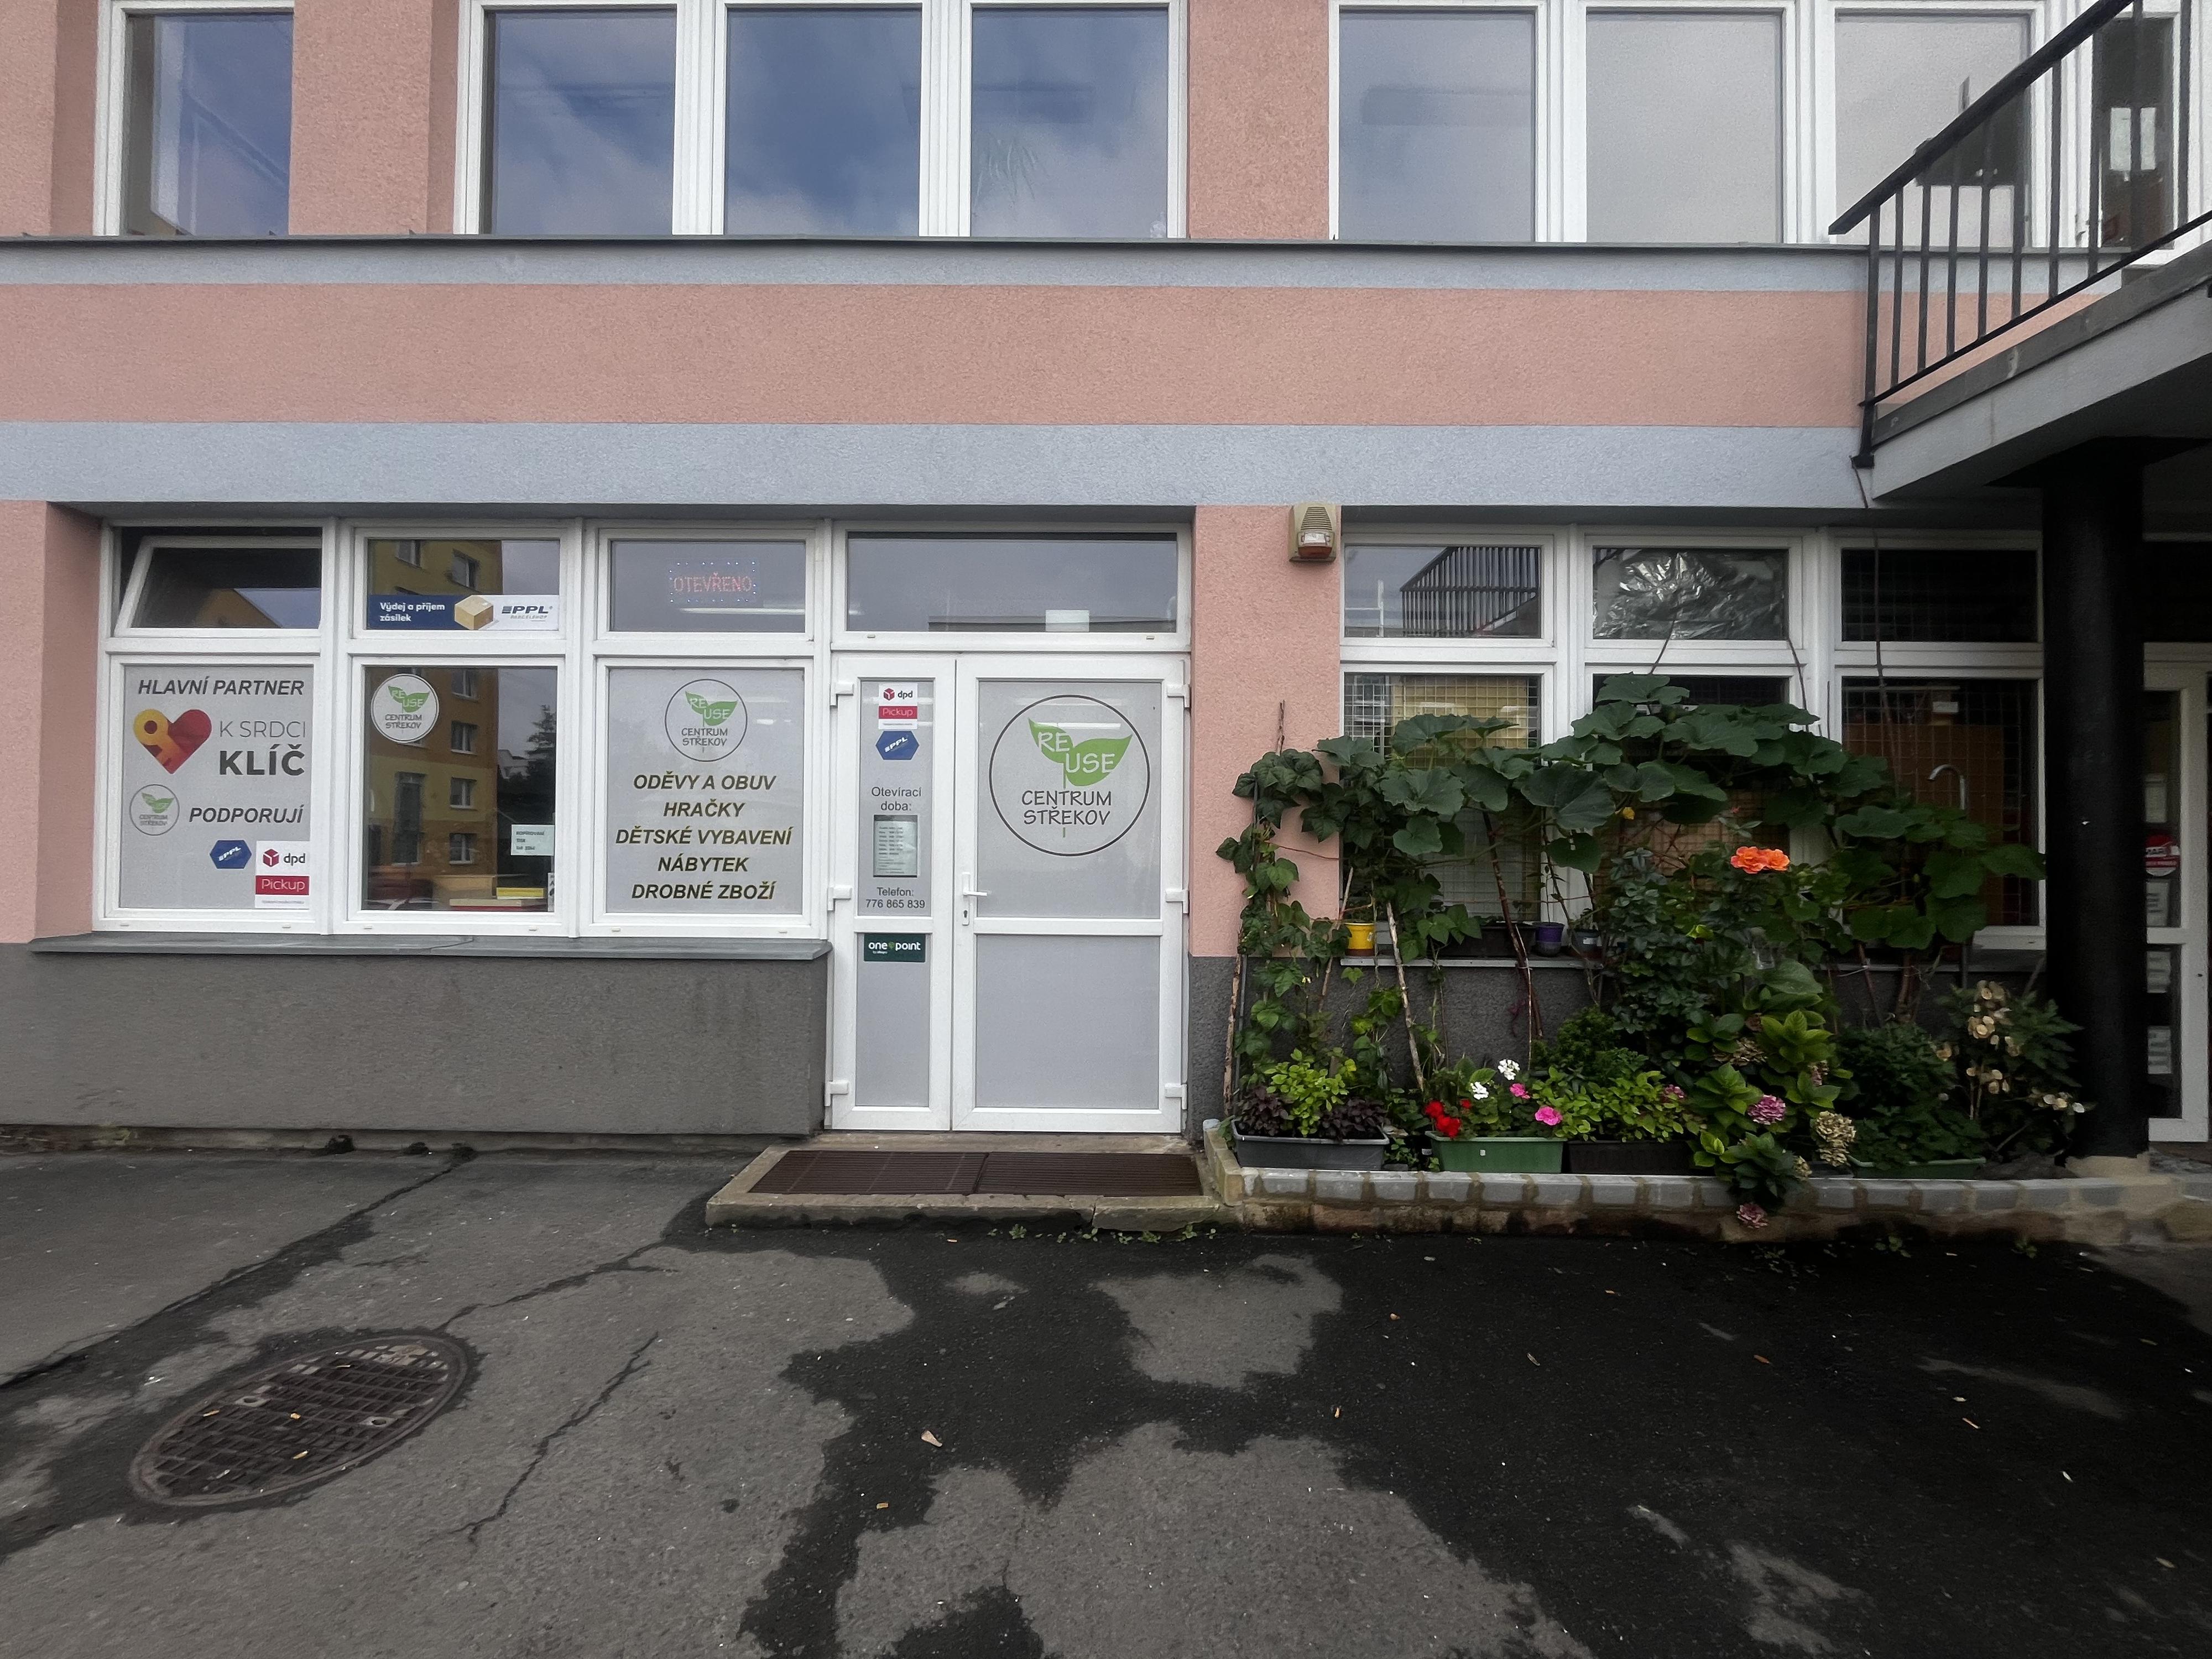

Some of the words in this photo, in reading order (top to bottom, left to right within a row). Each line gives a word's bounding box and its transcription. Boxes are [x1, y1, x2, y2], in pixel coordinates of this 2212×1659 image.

[673, 572, 752, 593] OTEVŘENO
[380, 602, 406, 612] Výdej
[416, 602, 445, 612] příjem
[138, 676, 210, 695] HLAVNÍ
[213, 680, 305, 696] PARTNER
[690, 698, 707, 708] RE
[898, 690, 913, 700] dpd
[704, 708, 731, 719] USE
[882, 707, 913, 717] Pickup
[220, 721, 236, 738] K
[239, 721, 306, 738] SRDCI
[681, 727, 728, 736] CENTRUM
[682, 736, 727, 746] STŘEKOV
[1037, 732, 1070, 752] RE
[219, 744, 305, 776] KLÍČ
[1065, 753, 1115, 773] USE
[633, 771, 700, 790] ODĚVY
[702, 775, 716, 790] A
[721, 775, 776, 790] OBUV
[871, 786, 922, 797] Otevírací
[1021, 790, 1112, 806] CENTRUM
[189, 805, 304, 823] PODPORUJÍ
[663, 799, 745, 817] HRAČKY
[881, 801, 912, 811] doba:
[1024, 806, 1110, 825] STŘEKOV
[615, 826, 692, 844] DĚTSKÉ
[698, 827, 794, 845] VYBAVENÍ
[283, 850, 306, 867] dpd
[658, 853, 749, 872] NÁBYTEK
[262, 878, 305, 892] Pickup
[632, 880, 713, 899] DROBNÉ
[717, 881, 778, 900] ZBOŽÍ
[877, 887, 914, 896] Telefon:
[865, 899, 884, 909] 776
[886, 899, 905, 909] 865
[907, 899, 926, 909] 839
[868, 942, 888, 950] one
[895, 942, 921, 951] point
